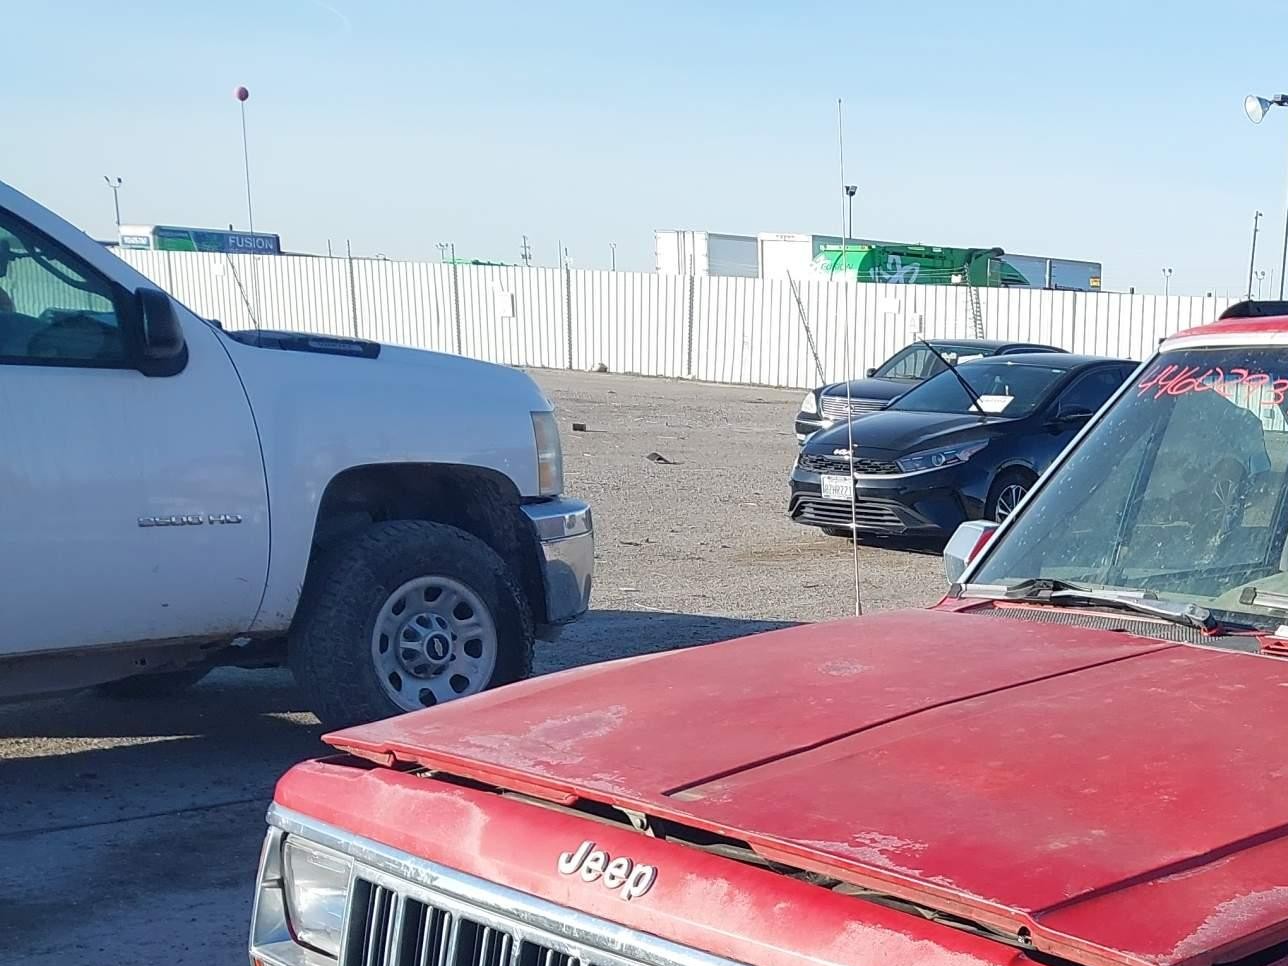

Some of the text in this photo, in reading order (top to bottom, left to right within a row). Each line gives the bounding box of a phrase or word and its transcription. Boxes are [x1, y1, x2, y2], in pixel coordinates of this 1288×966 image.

[228, 235, 274, 250] FUSION
[207, 513, 243, 525] HD
[558, 840, 659, 901] Jeep
